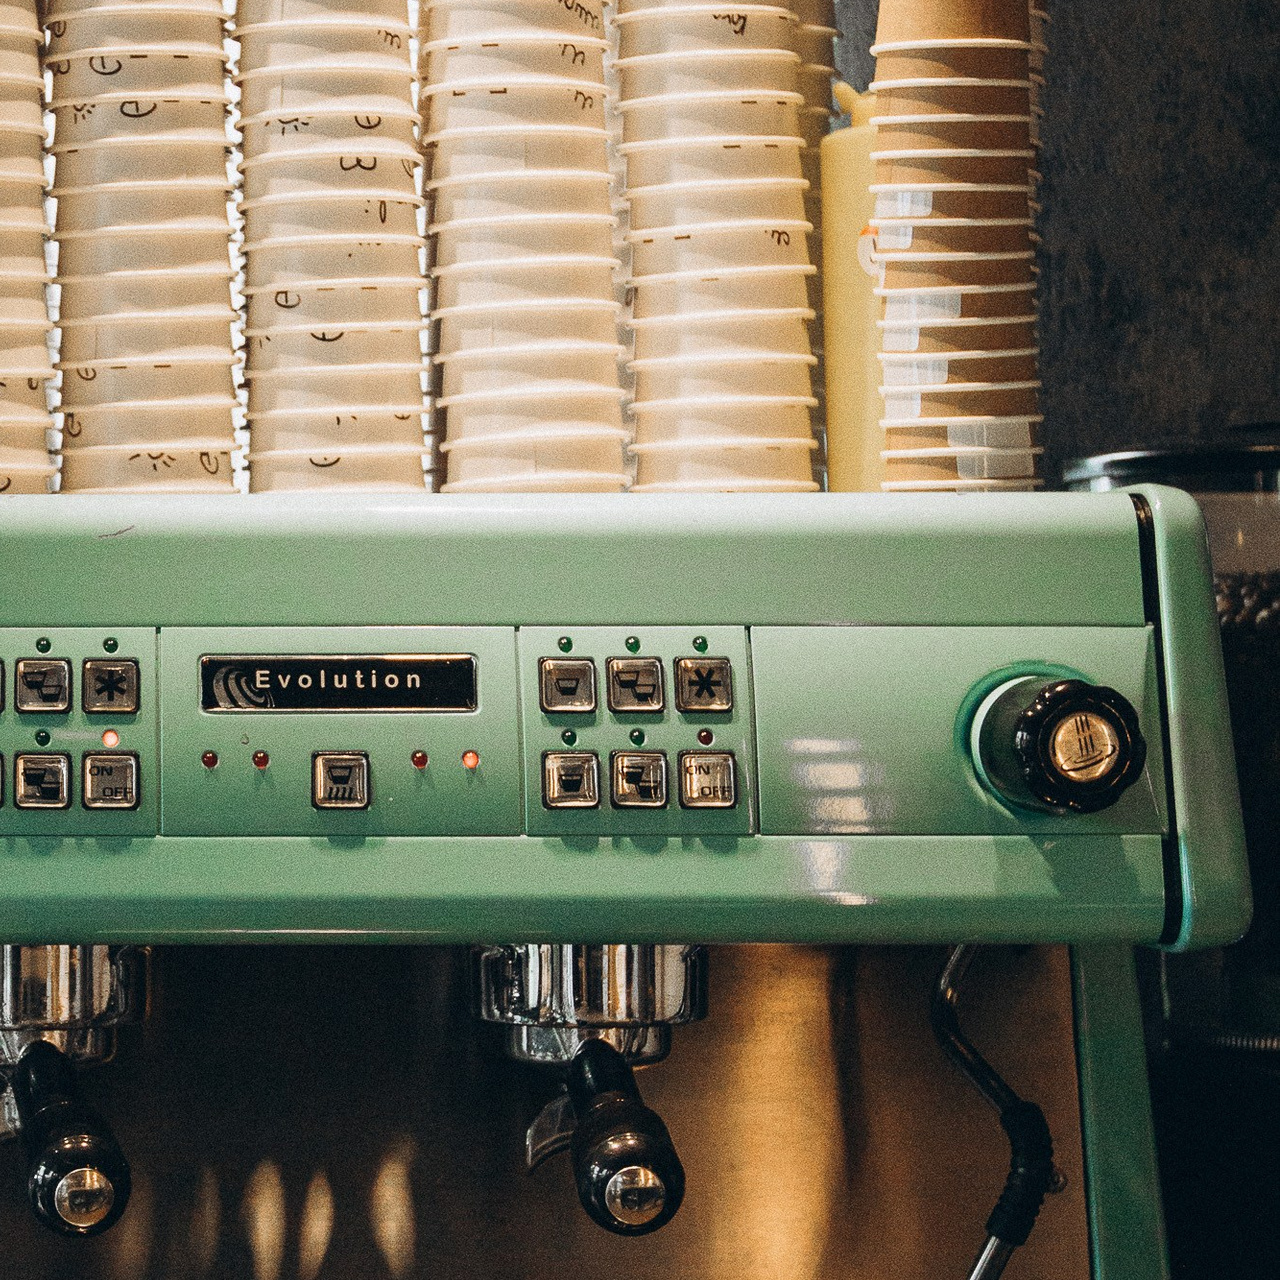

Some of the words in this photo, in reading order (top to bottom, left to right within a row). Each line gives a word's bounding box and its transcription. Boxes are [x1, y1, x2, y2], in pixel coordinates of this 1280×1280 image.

[254, 669, 421, 689] Evolution
[90, 765, 113, 776] ON
[685, 764, 711, 776] ON
[102, 786, 132, 798] OFF
[700, 786, 731, 798] OFF
